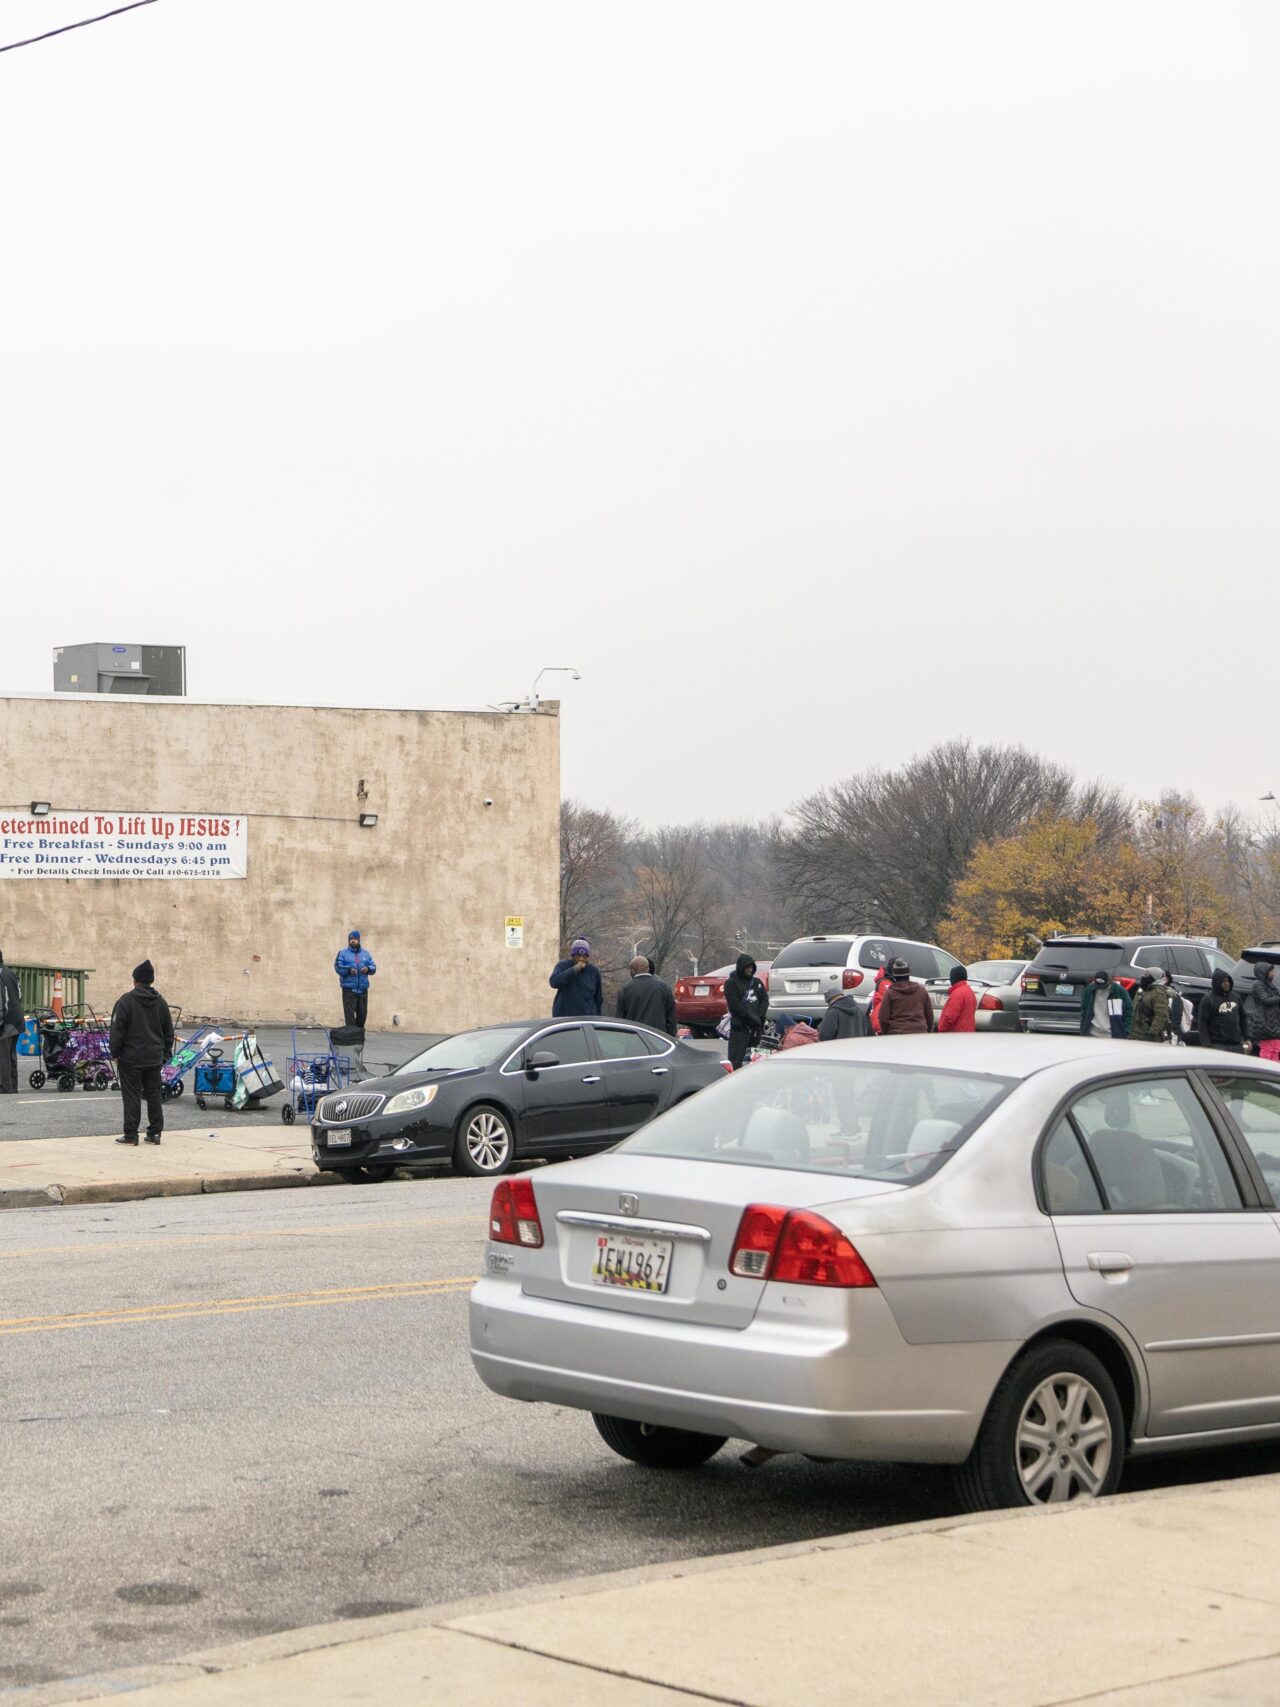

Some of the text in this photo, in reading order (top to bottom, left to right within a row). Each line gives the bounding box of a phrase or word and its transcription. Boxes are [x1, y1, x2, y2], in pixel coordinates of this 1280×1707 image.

[94, 816, 114, 835] To
[118, 816, 146, 835] Lift
[151, 817, 175, 839] Up
[178, 818, 230, 837] JESUS
[3, 838, 34, 849] Free
[38, 838, 105, 849] Breakfast
[116, 839, 174, 852] Sundays
[177, 841, 203, 851] 9:00
[206, 843, 227, 851] am
[0, 853, 30, 863] Free
[34, 853, 84, 864] Dinner
[94, 853, 178, 866] Wednesdays
[180, 855, 206, 865] 6:45
[210, 857, 231, 866] pm
[17, 867, 34, 875] For
[36, 867, 69, 875] Details
[71, 867, 100, 875] Check
[102, 867, 131, 875] Inside
[146, 868, 164, 876] Call
[596, 1247, 665, 1280] 1EW1967
